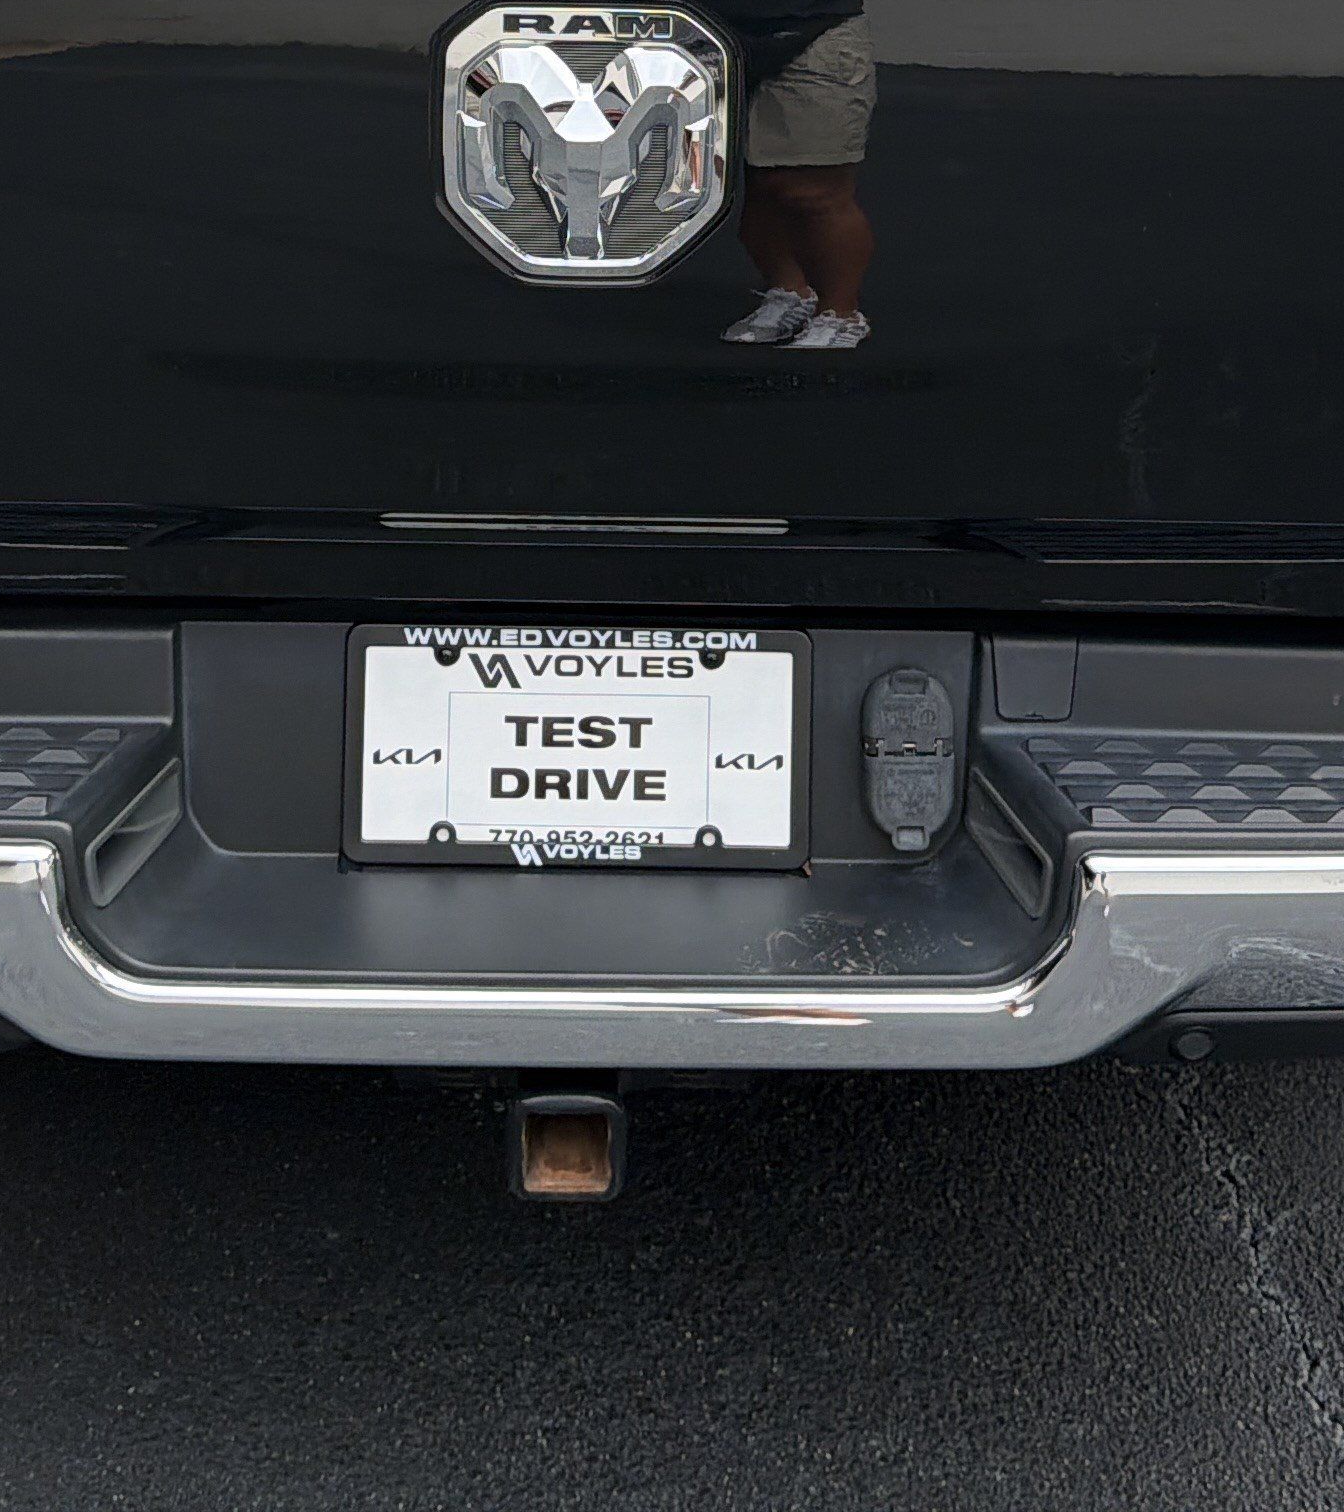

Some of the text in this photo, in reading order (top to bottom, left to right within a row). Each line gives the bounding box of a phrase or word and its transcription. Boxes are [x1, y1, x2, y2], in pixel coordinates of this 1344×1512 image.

[502, 13, 674, 39] RAM
[403, 626, 757, 651] WWW.EDVOYLES.COM
[523, 653, 695, 679] VOYLES
[503, 715, 654, 749] TEST
[489, 766, 667, 802] DRIVE
[542, 844, 642, 860] VOYLES
